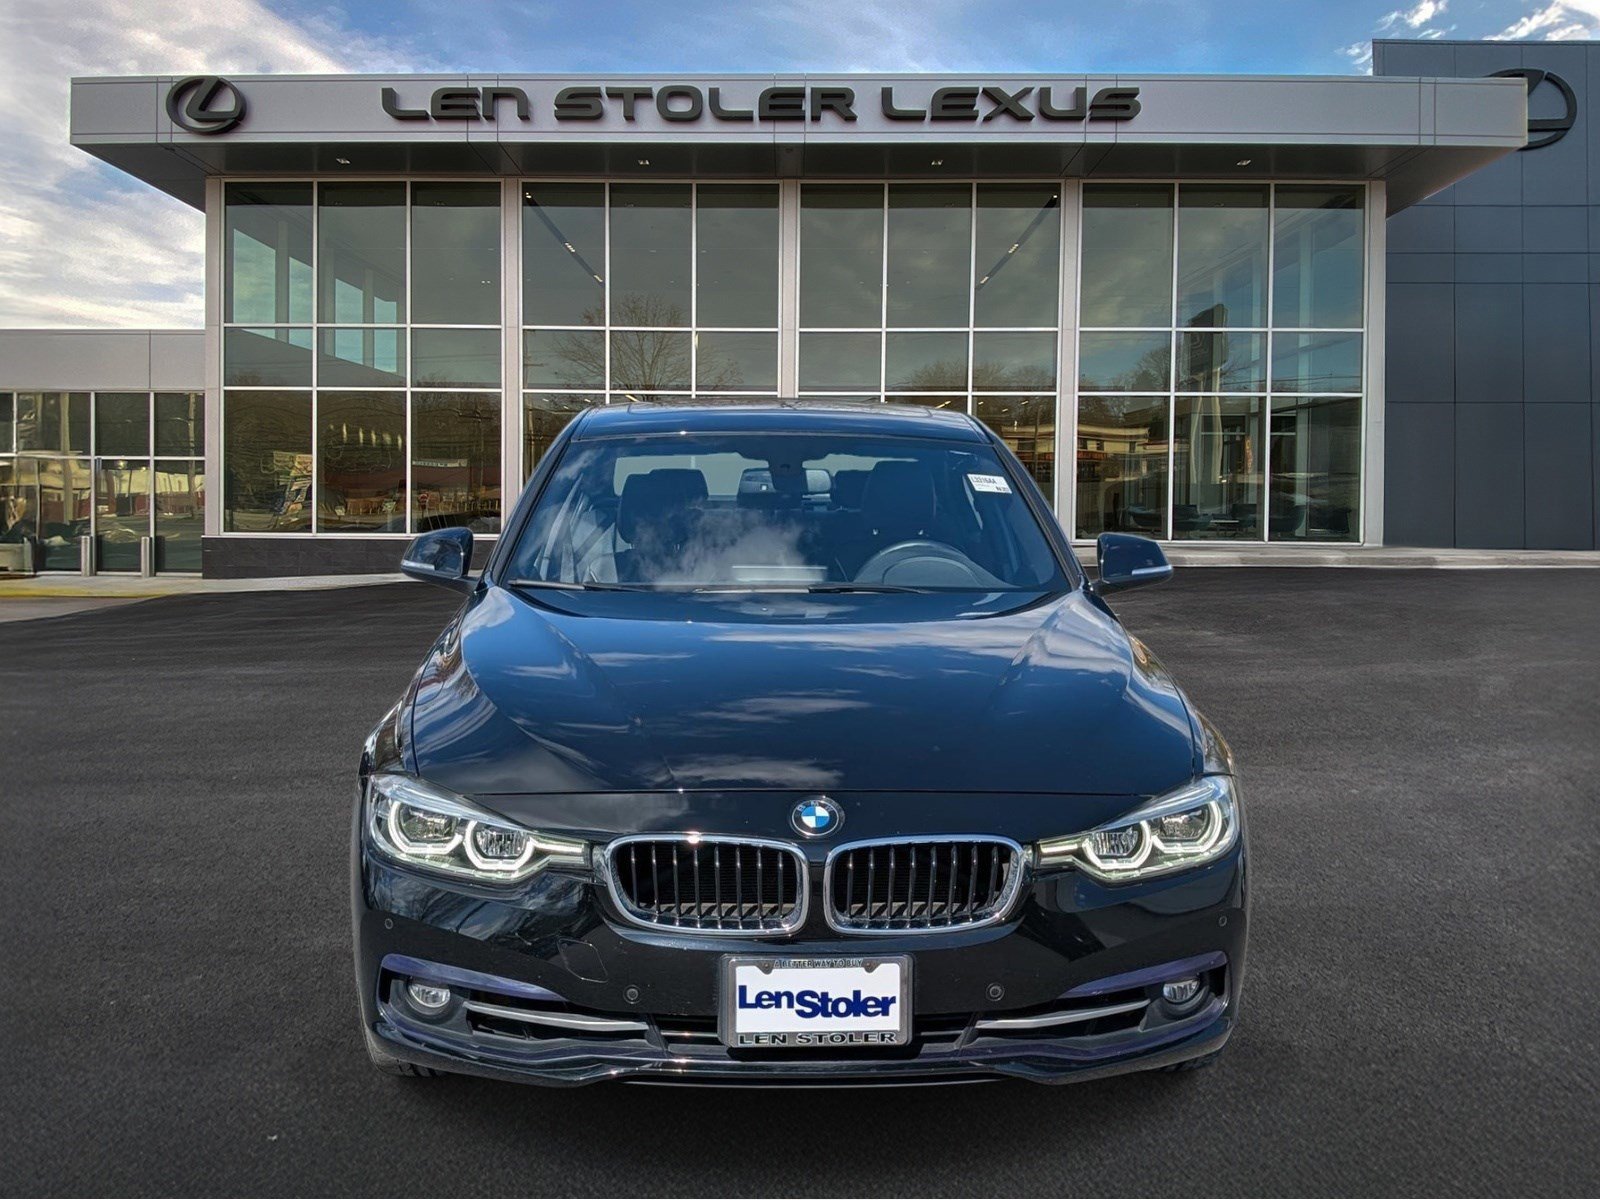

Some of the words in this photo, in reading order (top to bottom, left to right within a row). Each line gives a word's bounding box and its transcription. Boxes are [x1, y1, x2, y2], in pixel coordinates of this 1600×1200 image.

[381, 86, 530, 121] LEN
[554, 84, 857, 121] STOLER
[881, 86, 1141, 121] LEXUS
[781, 959, 812, 968] BETTER
[813, 959, 831, 968] WAY
[833, 958, 845, 968] TO
[845, 958, 864, 967] BUY
[737, 1032, 789, 1046] LEN
[796, 1031, 897, 1045] STOLER
